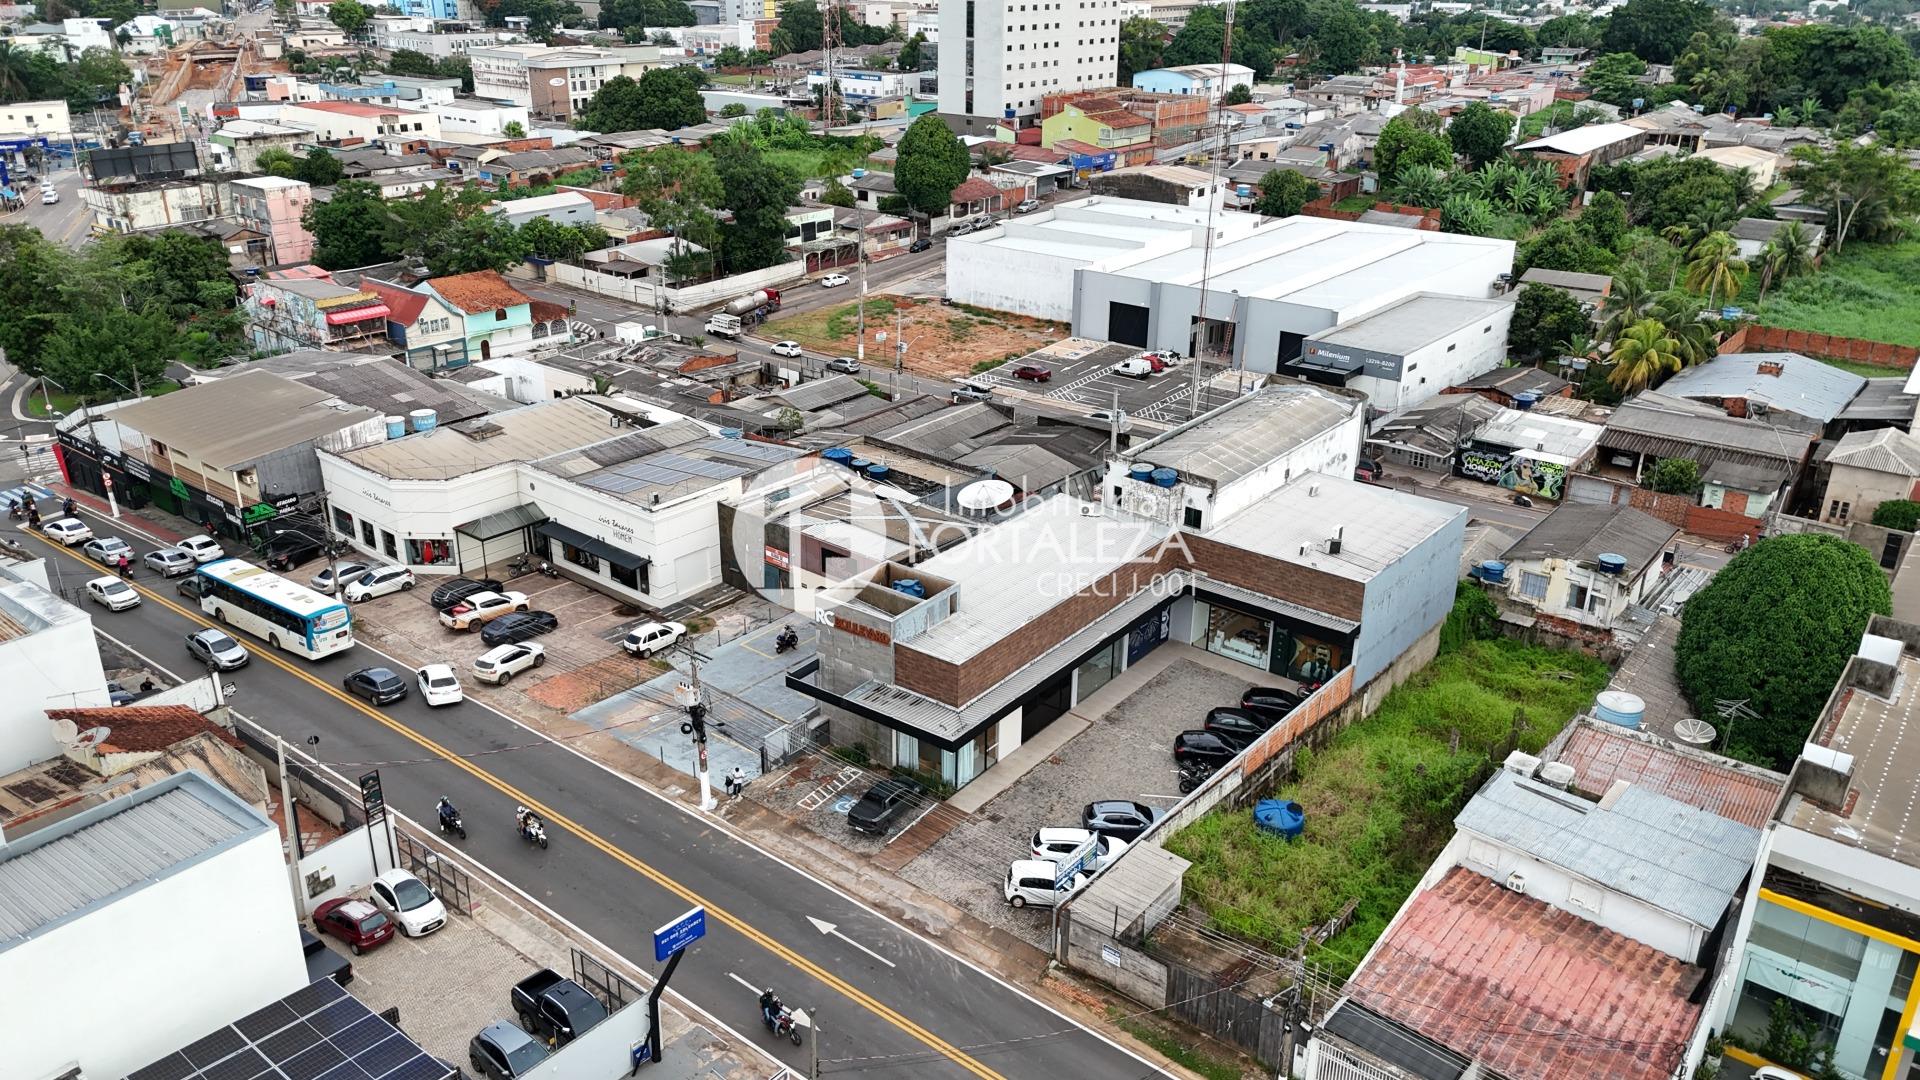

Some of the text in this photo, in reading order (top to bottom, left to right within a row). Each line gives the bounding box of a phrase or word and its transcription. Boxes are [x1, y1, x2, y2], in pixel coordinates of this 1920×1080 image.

[1317, 349, 1350, 361] Milenium
[1466, 456, 1502, 468] AMAZON
[1464, 463, 1501, 475] HOOKAH
[815, 607, 891, 646] RC BOULEVARD
